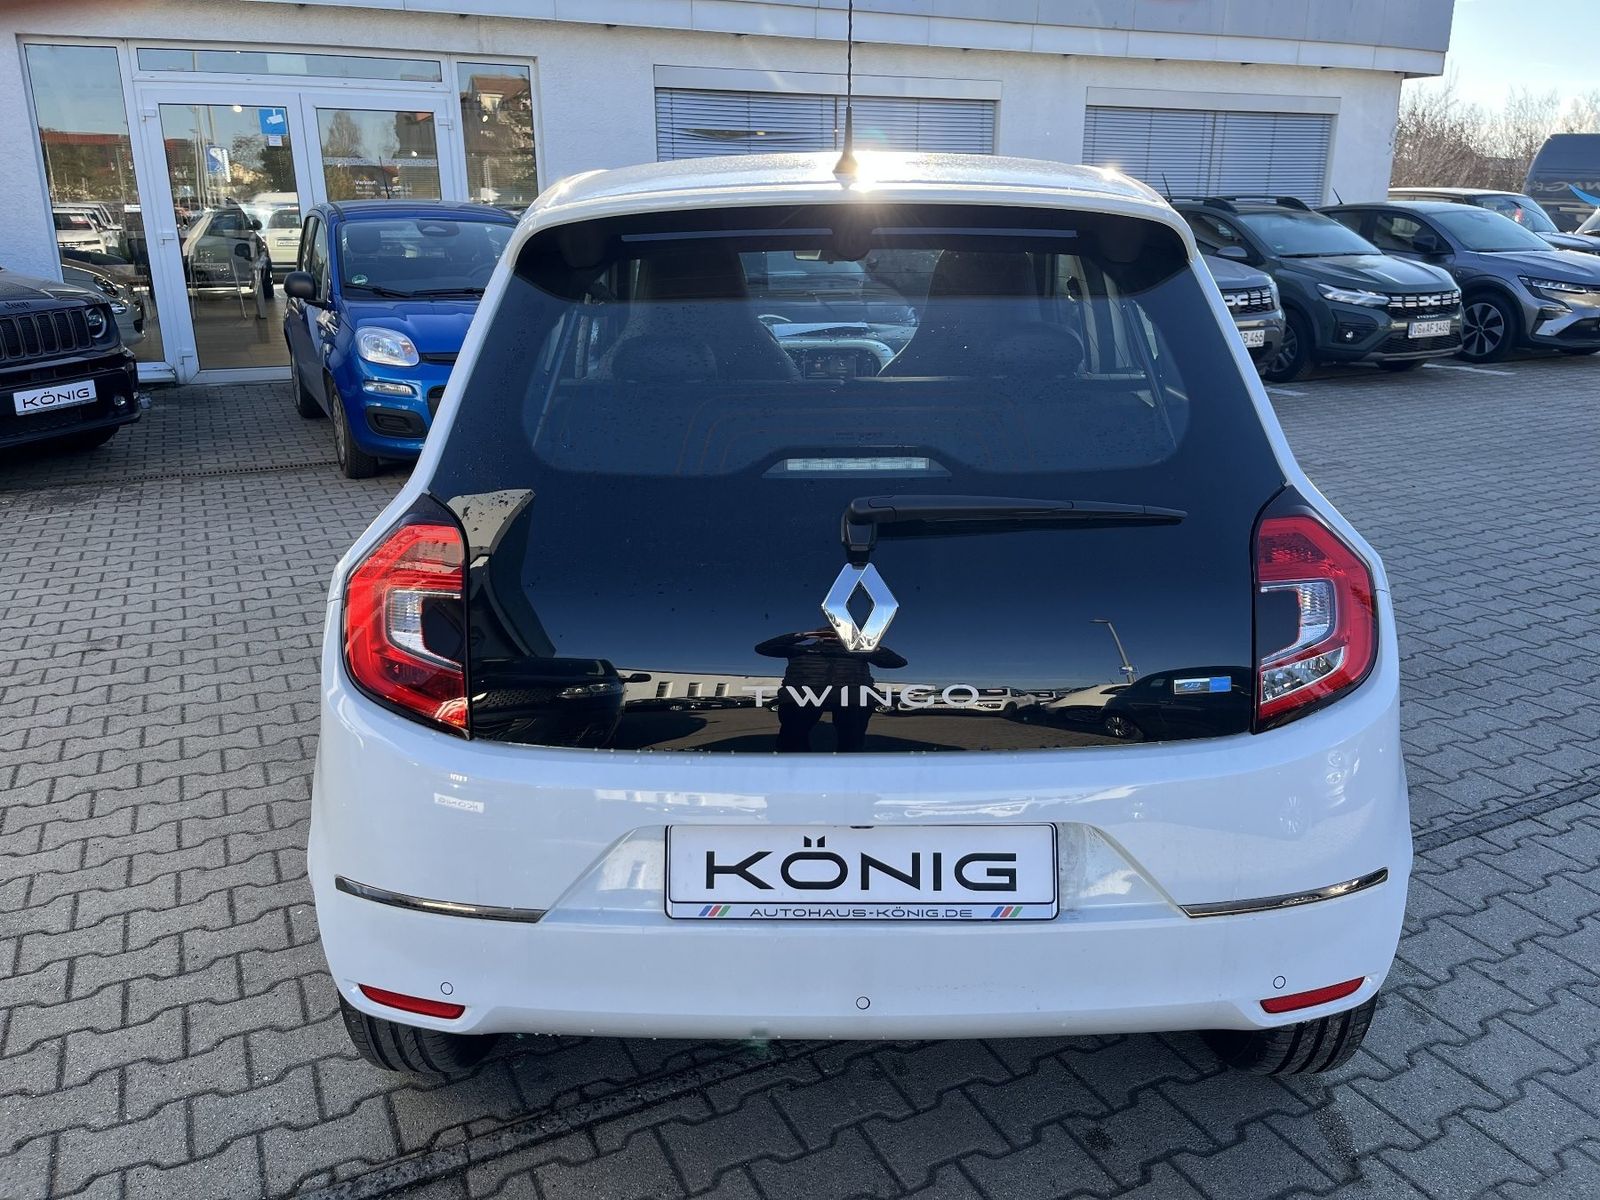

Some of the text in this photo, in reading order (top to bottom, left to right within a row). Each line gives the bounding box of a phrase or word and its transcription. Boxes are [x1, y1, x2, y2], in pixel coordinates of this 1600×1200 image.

[22, 387, 90, 408] KÖNIG
[742, 684, 979, 708] TWINGO
[705, 835, 1017, 892] KÖNIG
[750, 906, 973, 918] AUTOHAUS-KÖNIG.DE
